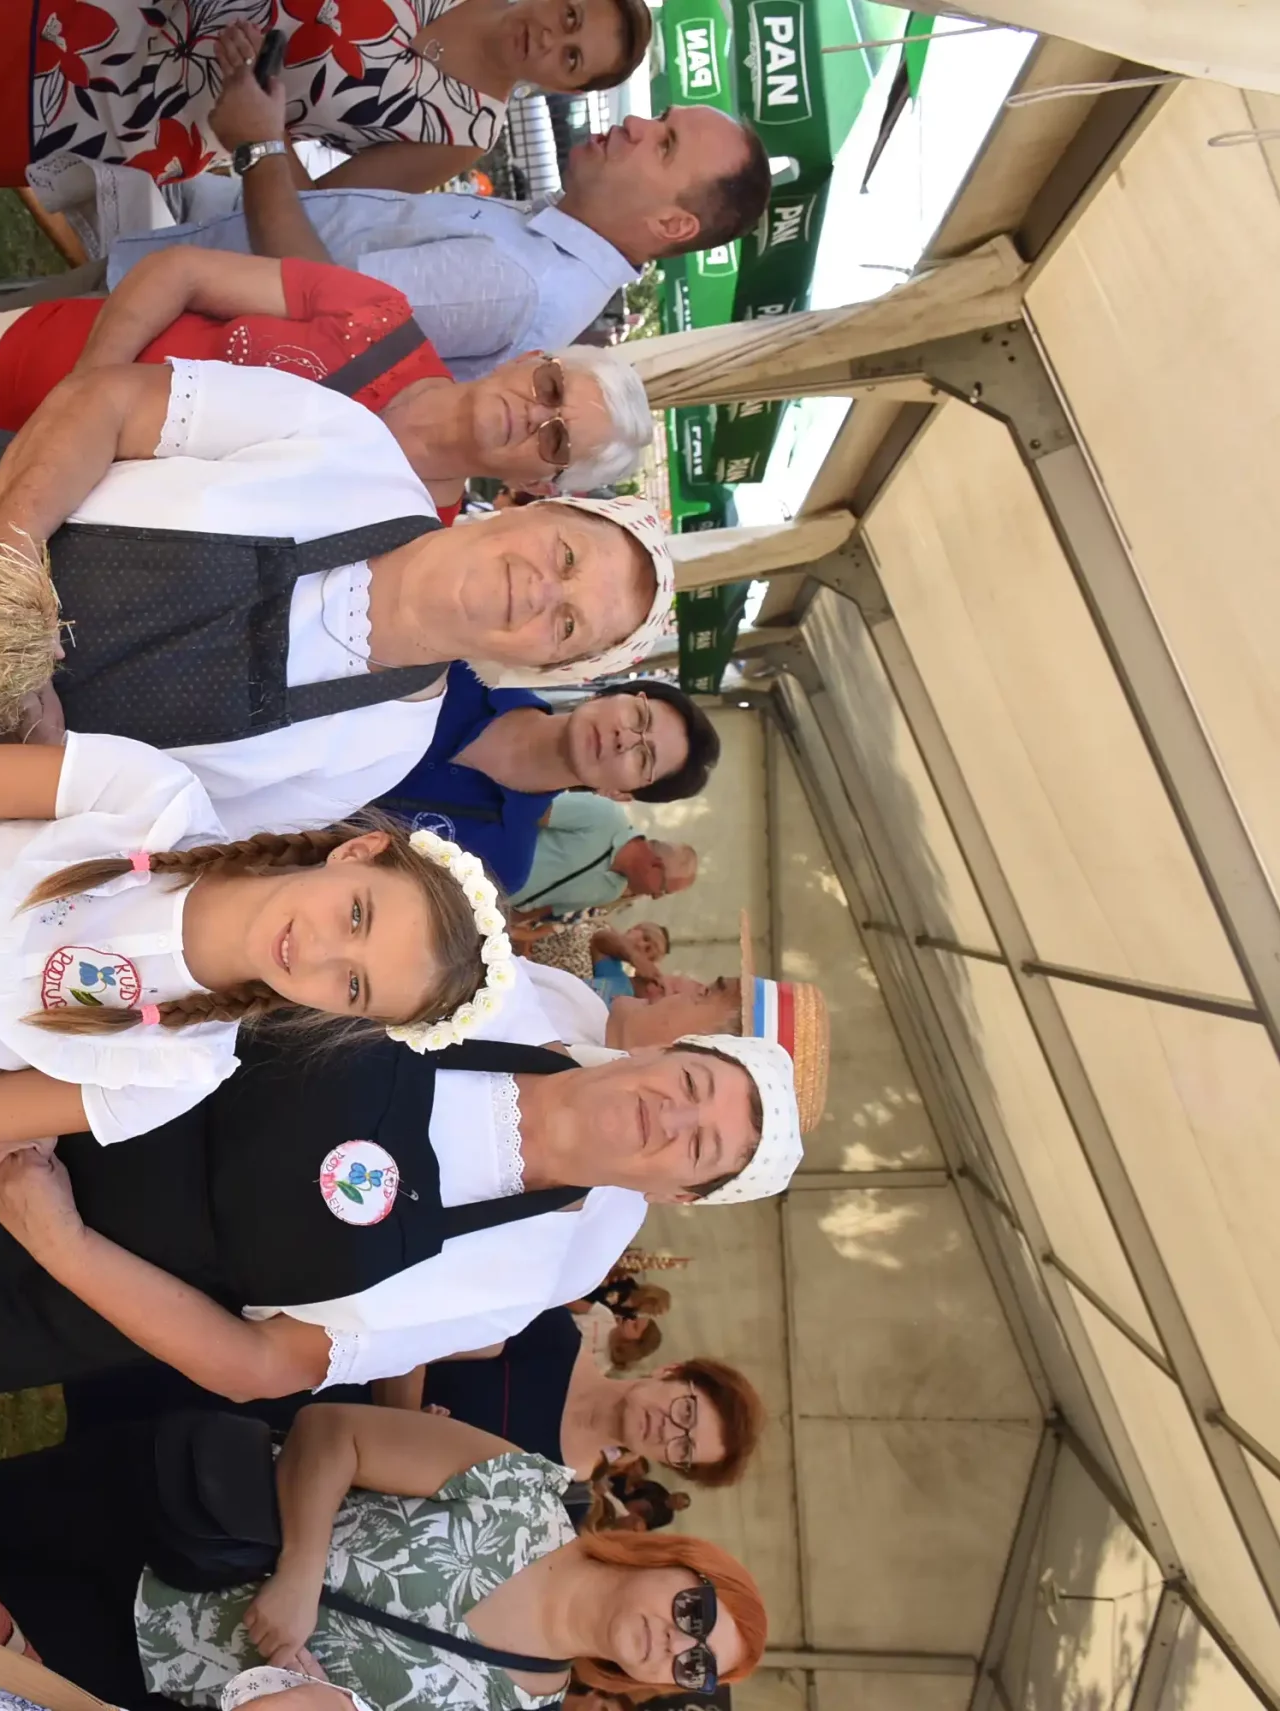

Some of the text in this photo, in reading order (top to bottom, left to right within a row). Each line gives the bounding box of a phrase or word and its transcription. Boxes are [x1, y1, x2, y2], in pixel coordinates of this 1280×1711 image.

[763, 16, 799, 106] PAN
[770, 204, 804, 247] PAN
[45, 951, 74, 1009] PODTUR
[114, 964, 138, 1001] KUD
[383, 1165, 396, 1199] KUD
